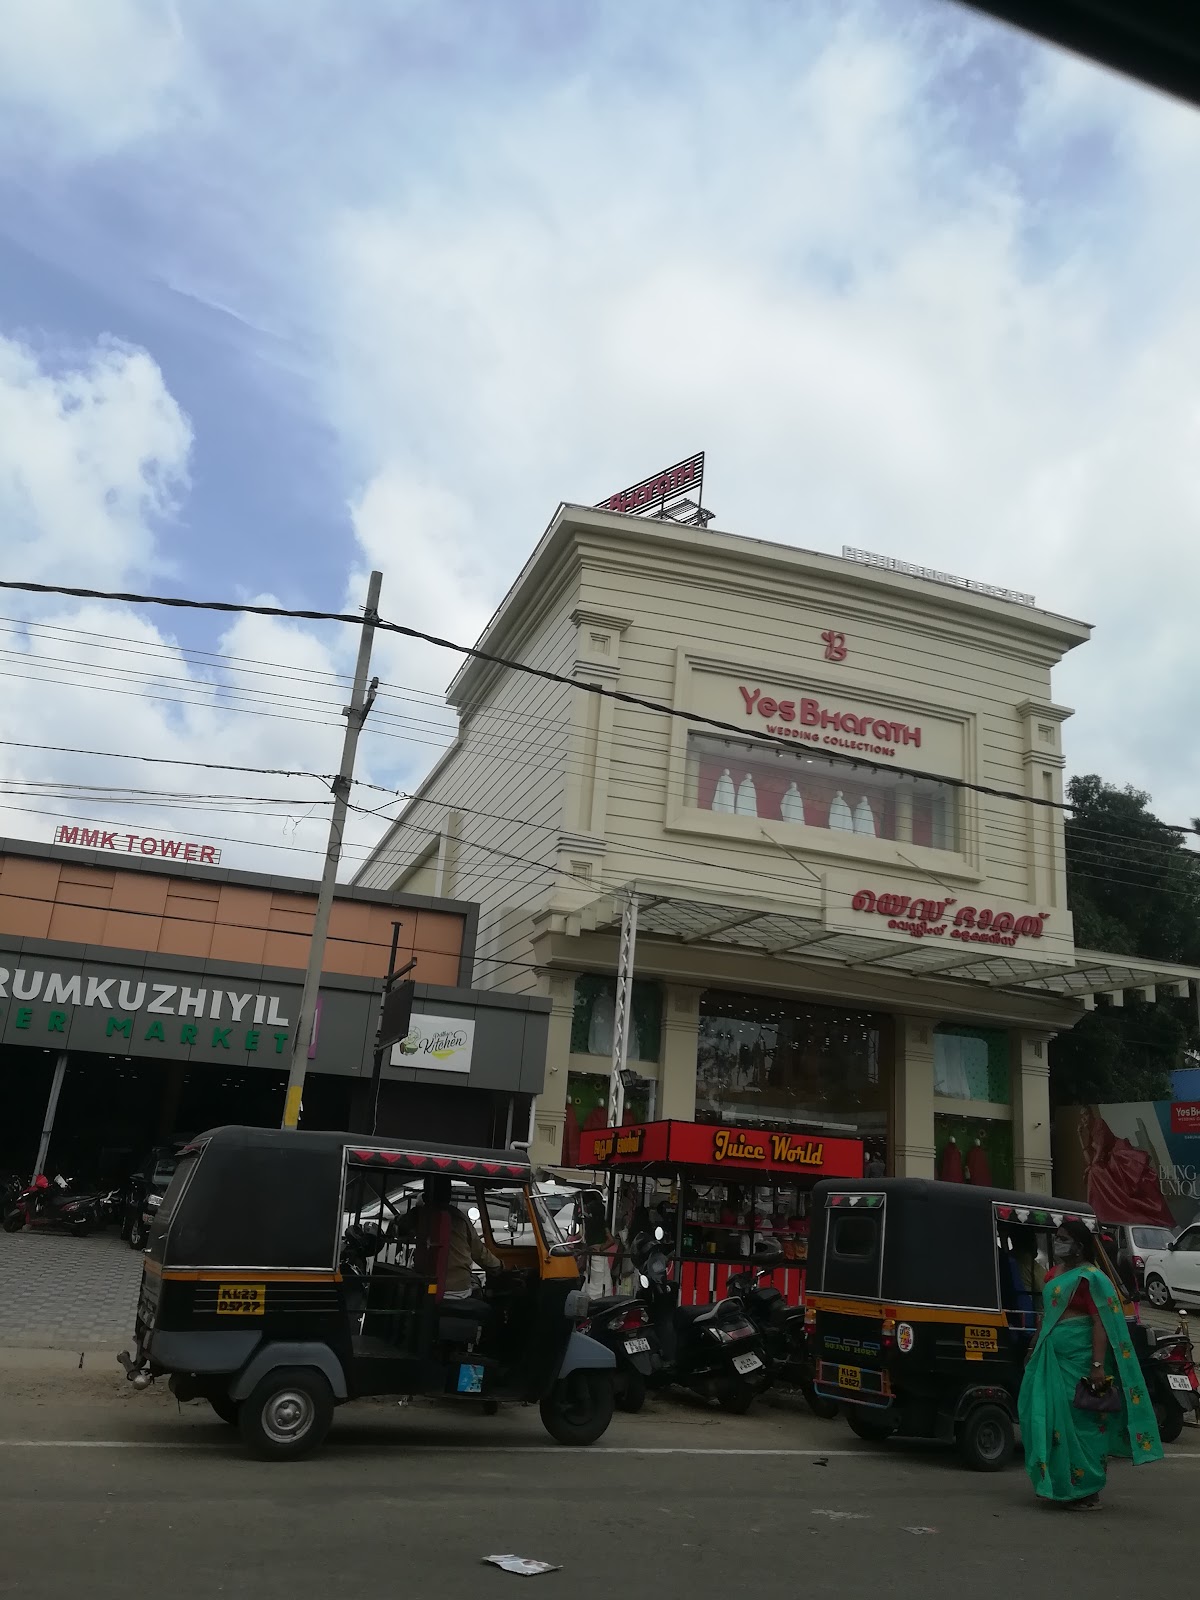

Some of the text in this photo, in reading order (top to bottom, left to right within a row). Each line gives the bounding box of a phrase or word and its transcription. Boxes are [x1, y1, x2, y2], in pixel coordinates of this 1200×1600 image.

[766, 724, 896, 757] WEDDING COLLECTIONS
[60, 825, 216, 864] MMK TOWER
[106, 1016, 289, 1054] MARKET
[419, 1030, 467, 1055] Kitchen
[715, 1131, 824, 1166] Juice World
